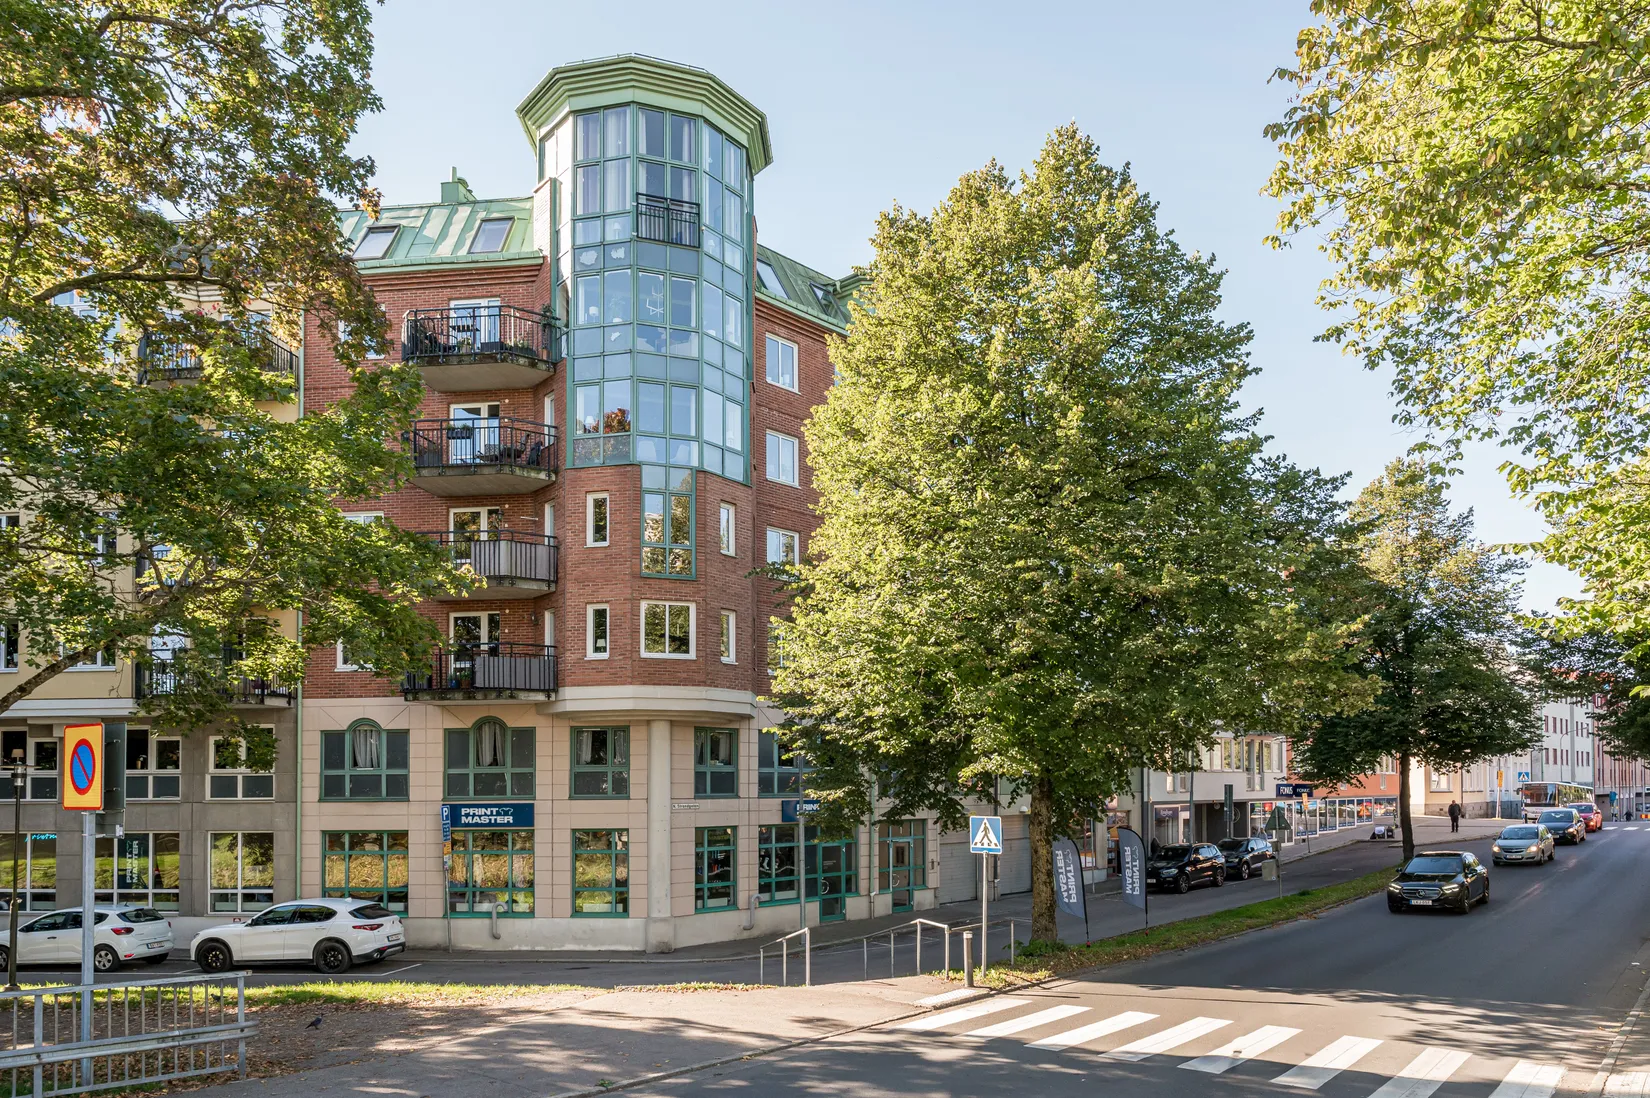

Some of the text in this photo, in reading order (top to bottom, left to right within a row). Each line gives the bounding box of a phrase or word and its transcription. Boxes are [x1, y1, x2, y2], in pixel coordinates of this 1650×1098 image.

[1280, 786, 1293, 795] FONUS
[443, 807, 448, 820] P
[461, 807, 499, 816] PRINT
[461, 816, 514, 824] MASTER
